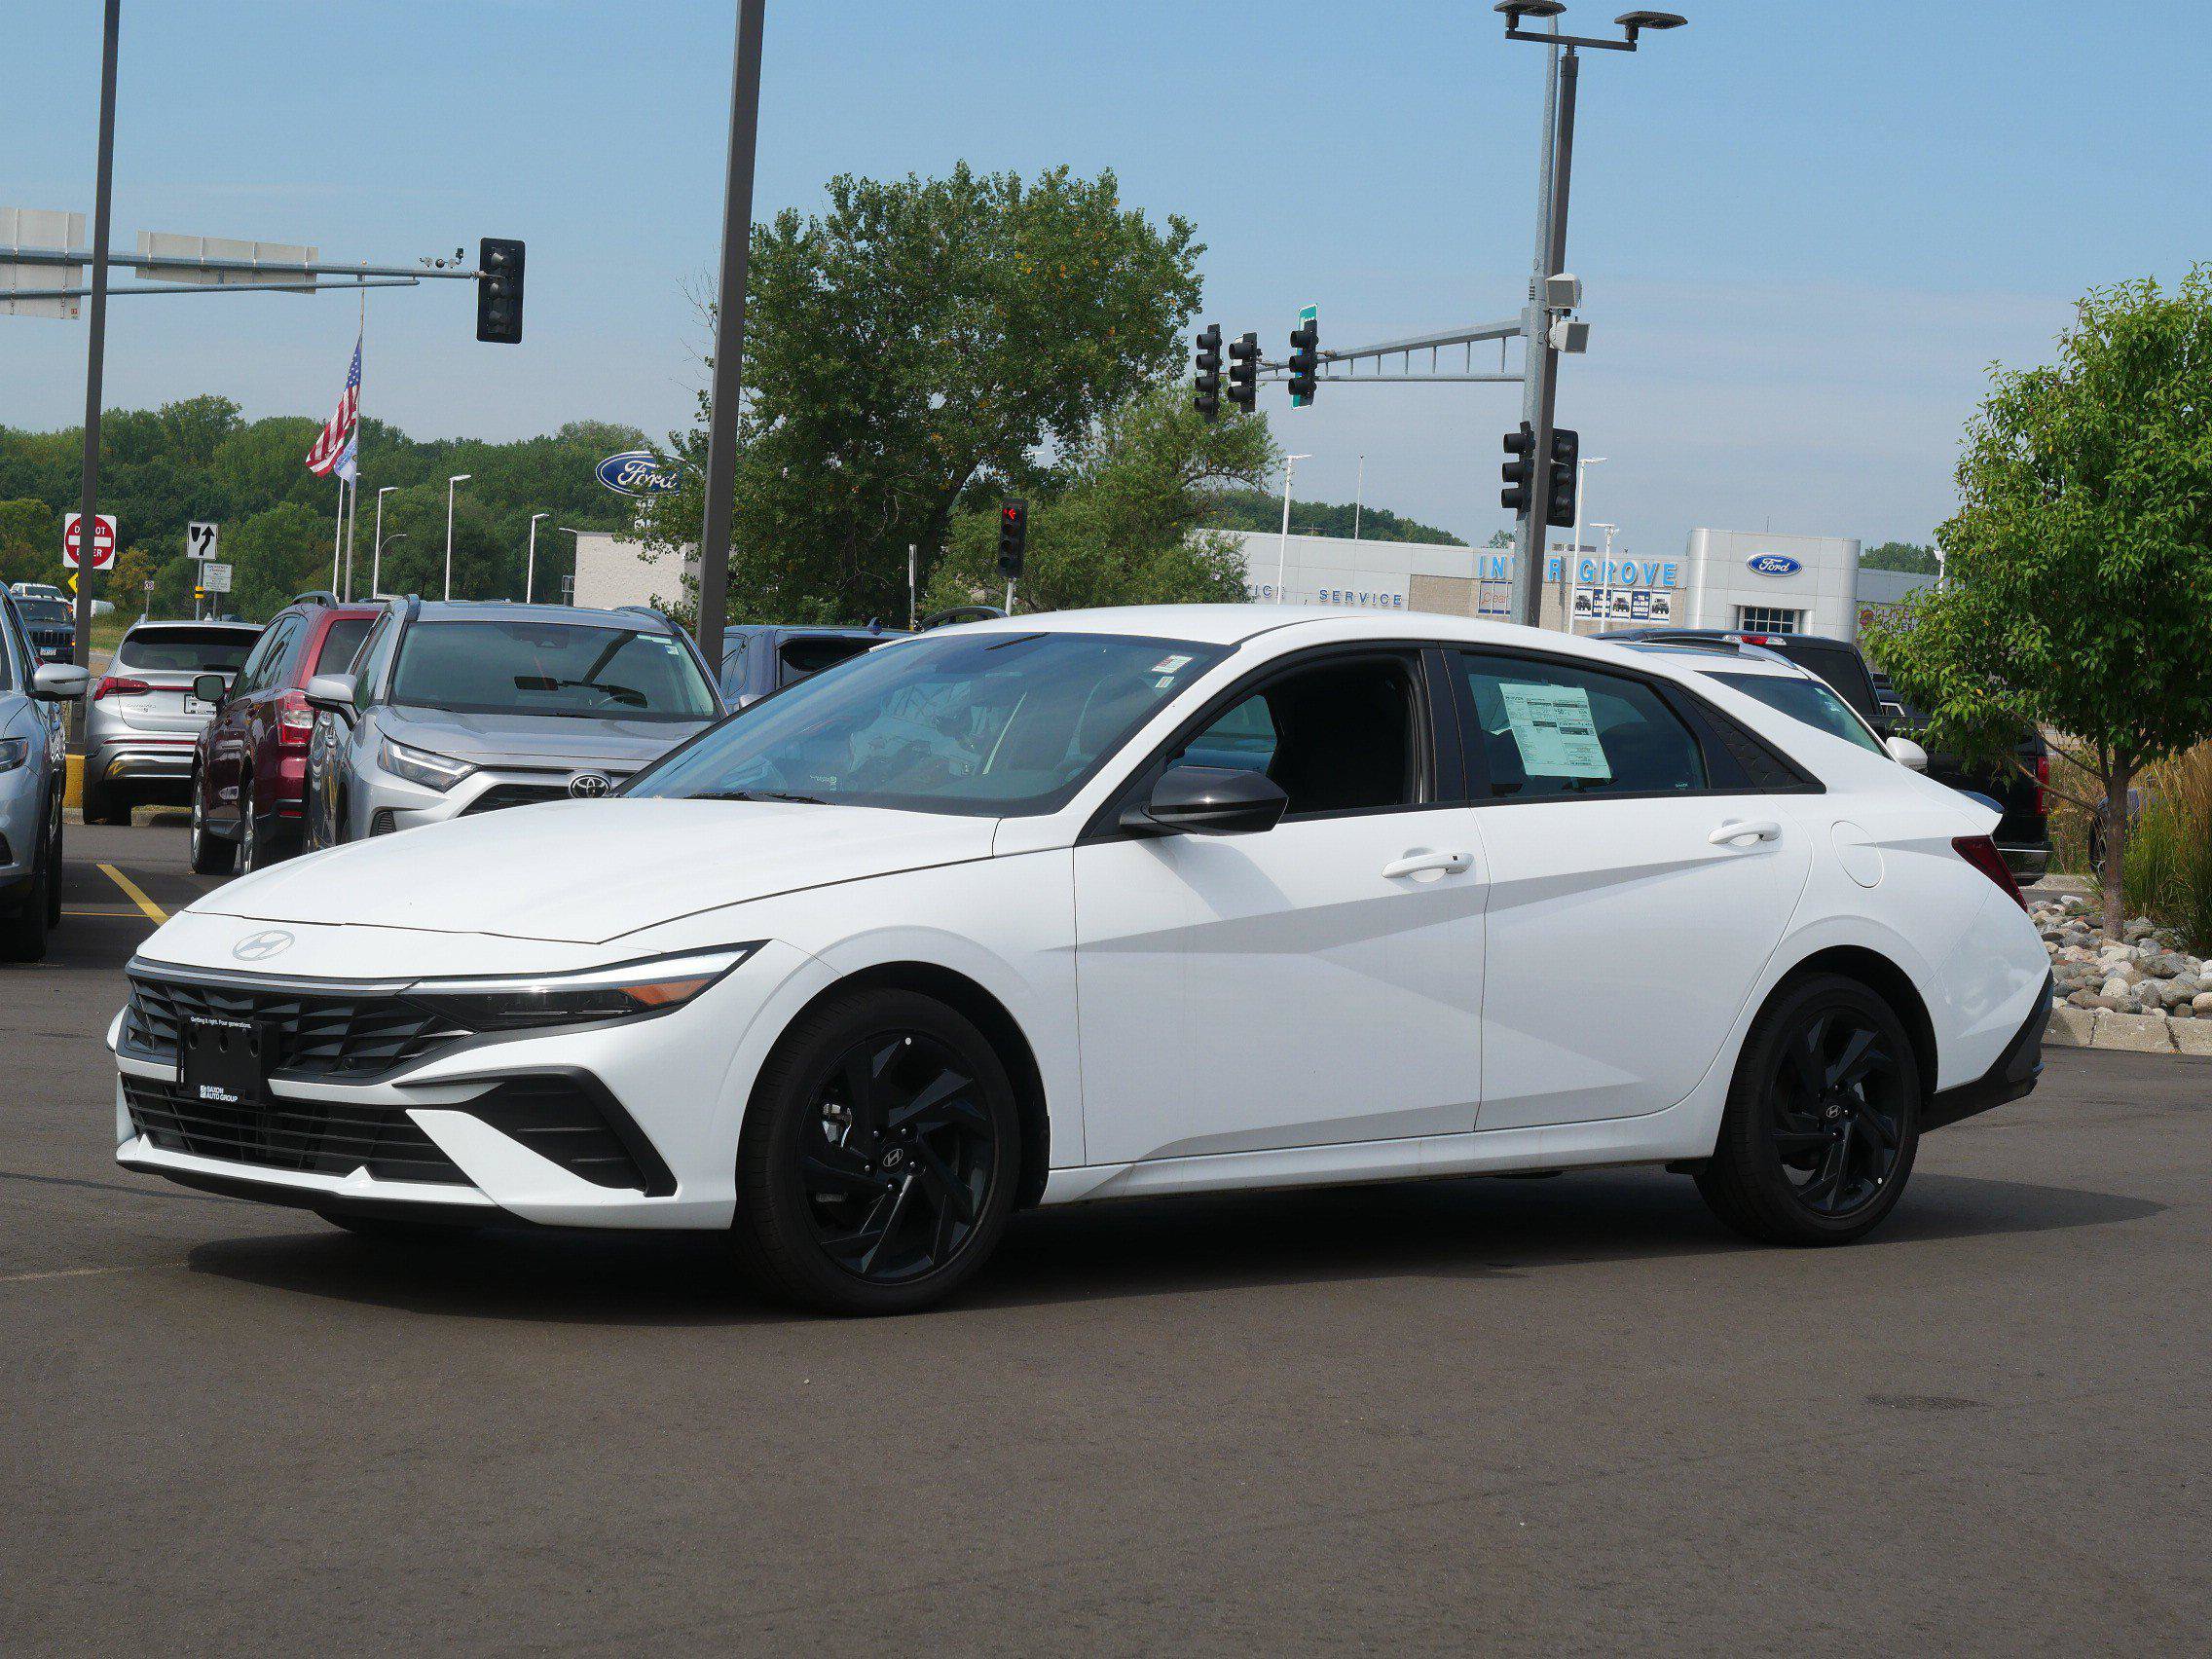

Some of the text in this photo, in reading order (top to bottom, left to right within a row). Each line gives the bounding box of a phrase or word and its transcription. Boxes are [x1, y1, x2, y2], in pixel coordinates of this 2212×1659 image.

[617, 461, 678, 489] Ford
[1477, 555, 1677, 587] INR GROVE
[1758, 558, 1791, 572] Ford
[1318, 588, 1403, 607] SERVICE
